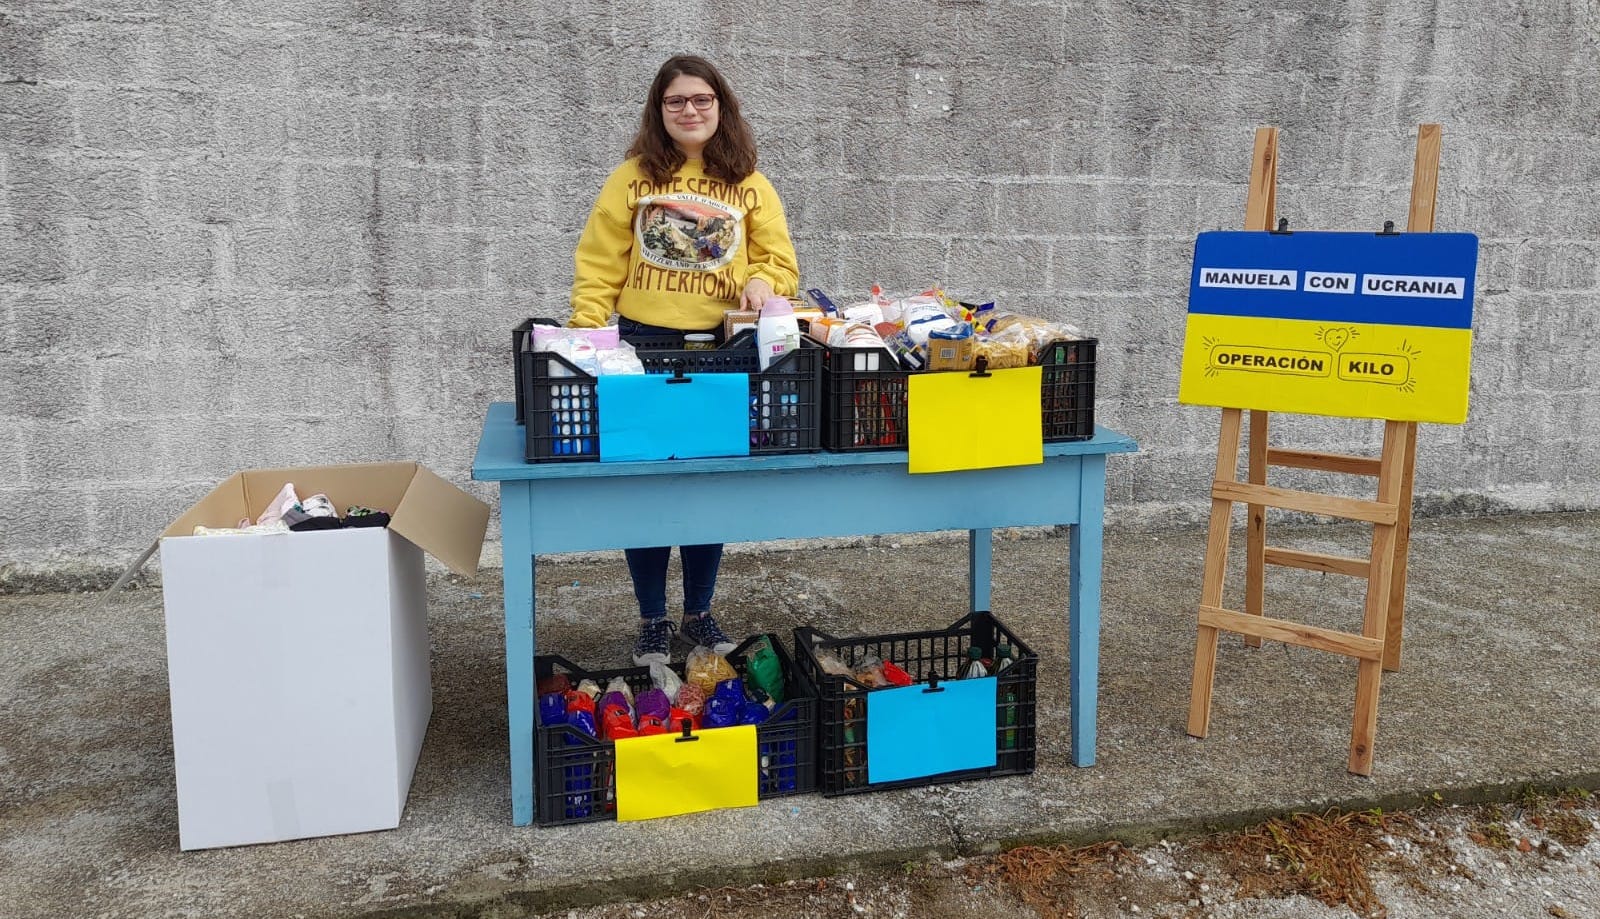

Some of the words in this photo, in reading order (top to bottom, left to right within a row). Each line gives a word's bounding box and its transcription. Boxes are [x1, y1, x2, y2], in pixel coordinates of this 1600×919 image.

[627, 176, 682, 211] MONTE
[686, 177, 762, 216] CERVINO
[1204, 271, 1291, 287] MANUELA
[1309, 276, 1350, 290] CON
[1367, 279, 1457, 295] UCRANIA
[1217, 353, 1324, 372] OPERACIÓN
[1348, 360, 1394, 376] KILO
